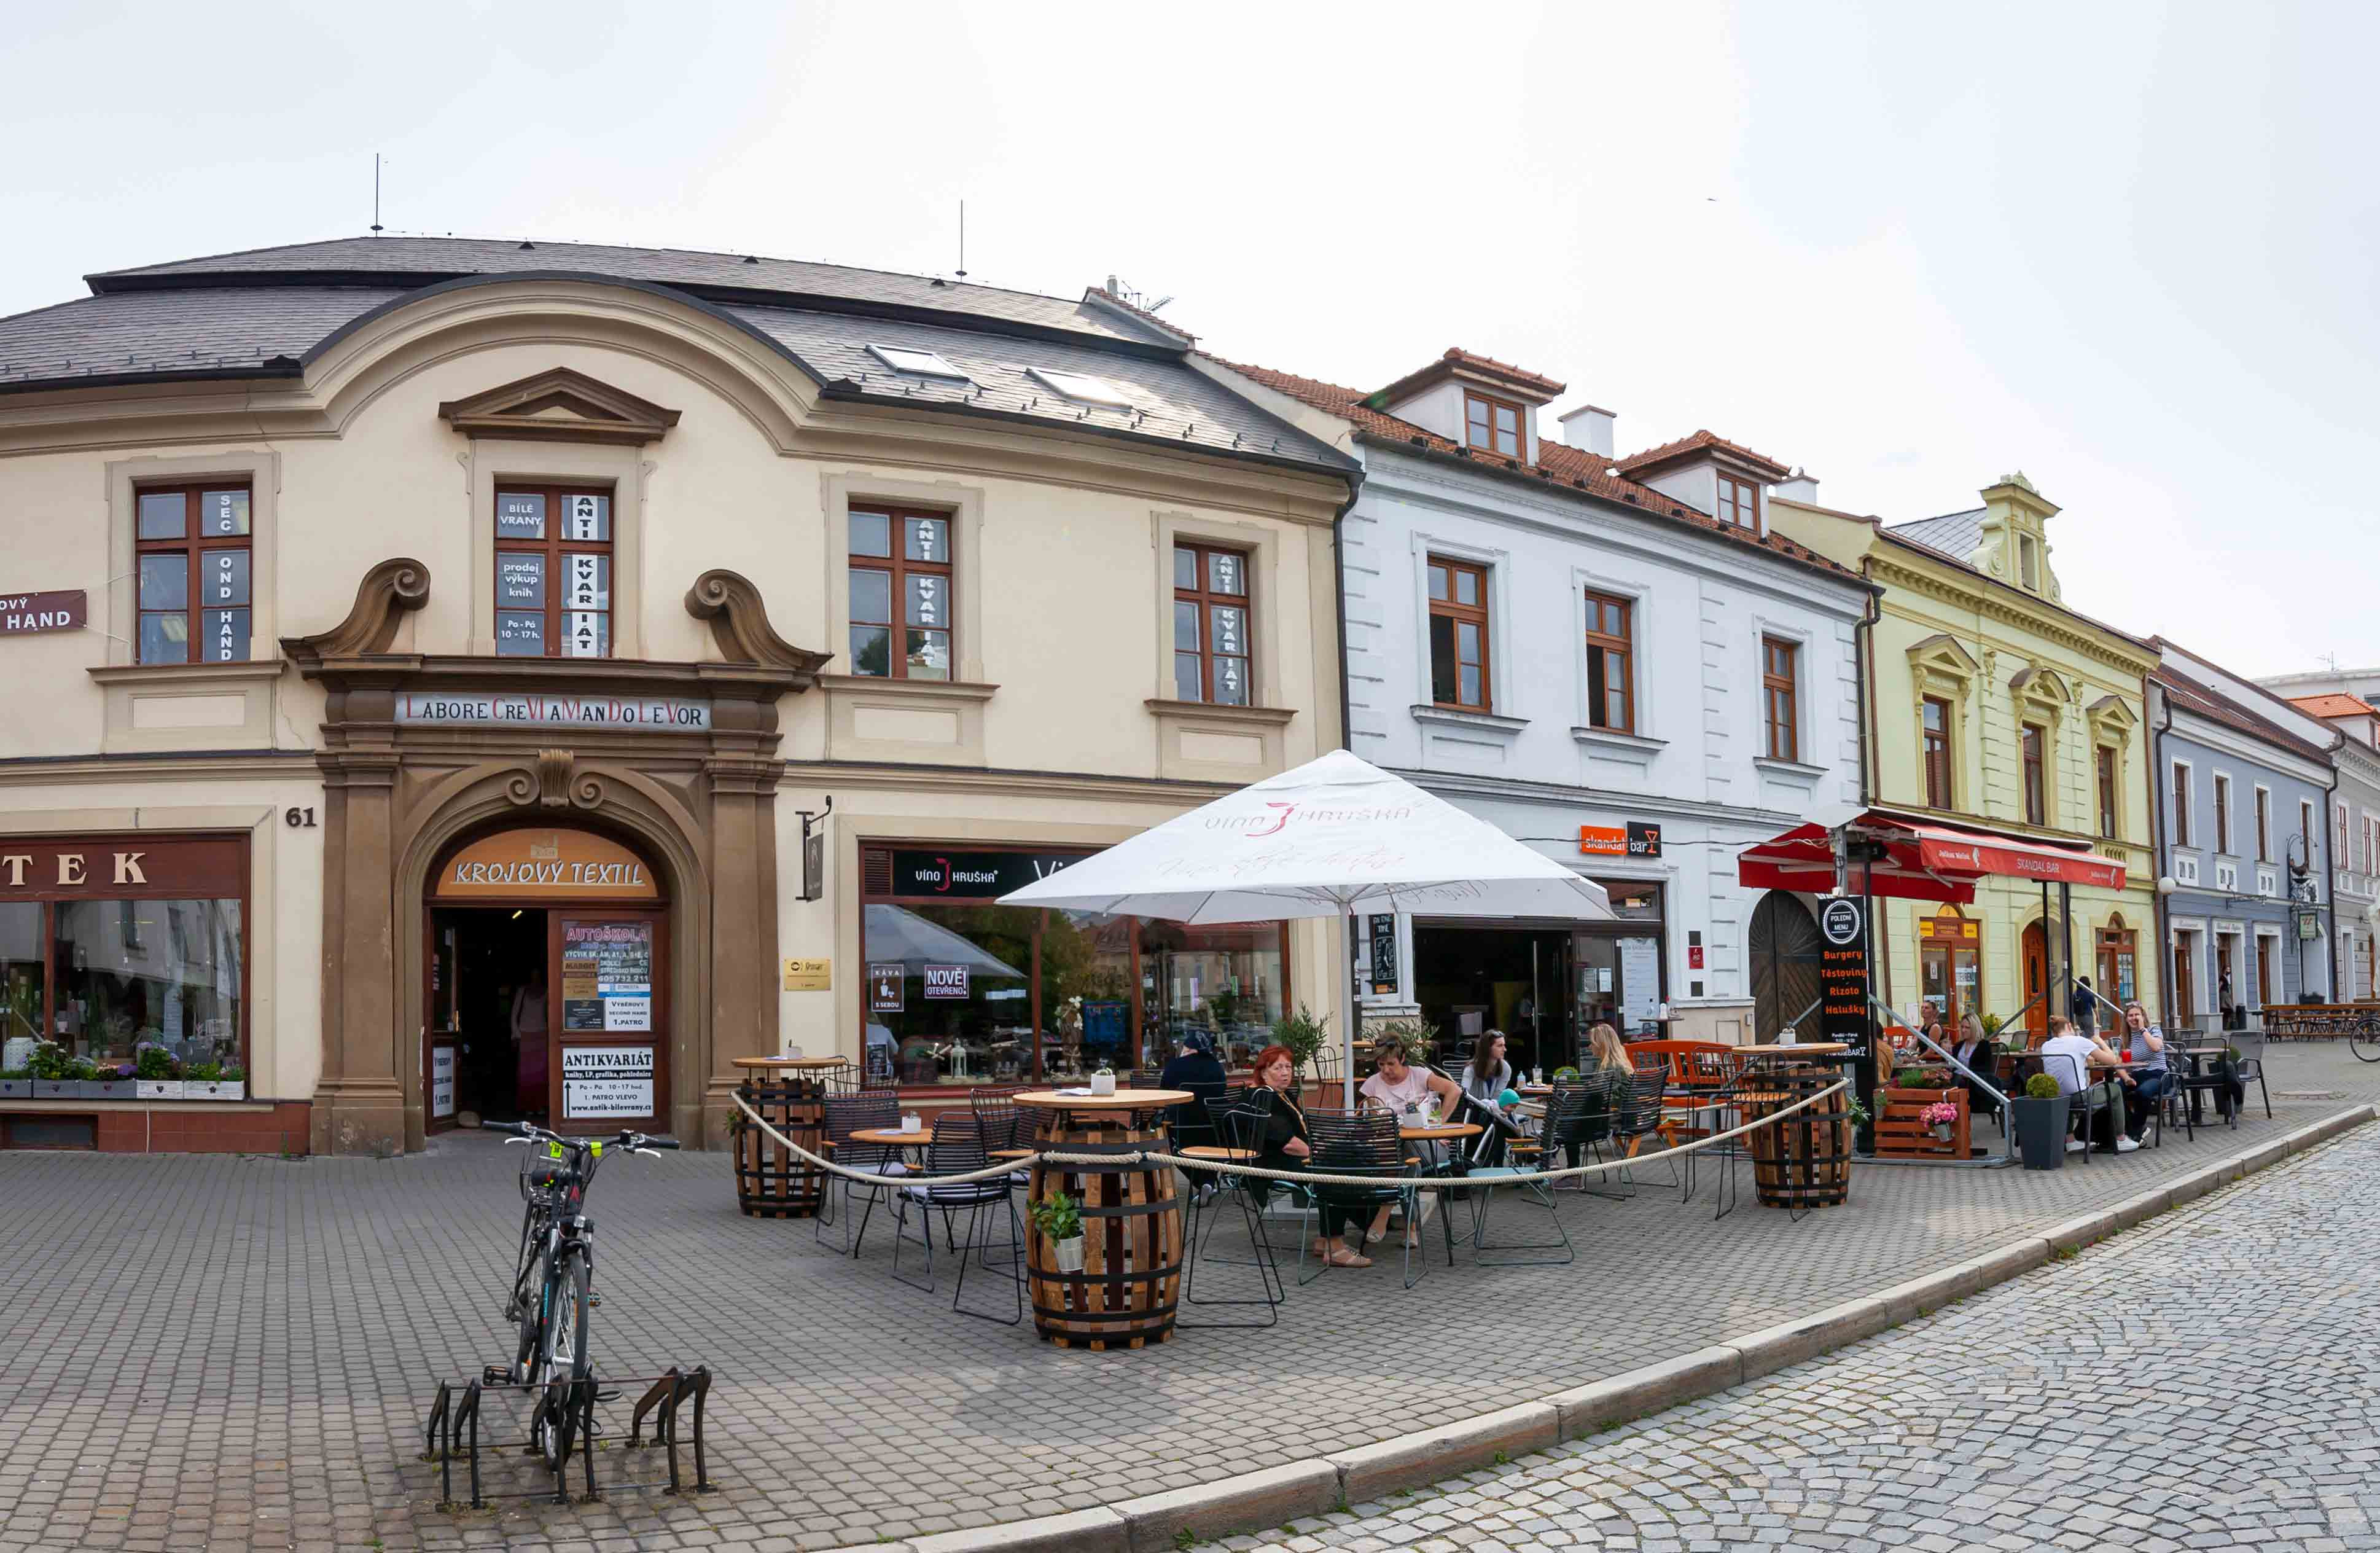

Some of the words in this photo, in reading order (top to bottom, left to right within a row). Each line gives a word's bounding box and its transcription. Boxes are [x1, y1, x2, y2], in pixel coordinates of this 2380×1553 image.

[509, 503, 534, 514] BÍLÉ
[500, 515, 541, 526] VRANY
[504, 563, 539, 573] prodej
[505, 574, 537, 585] výkup
[509, 588, 533, 598] knih
[7, 611, 71, 629] HAND
[285, 807, 318, 827] 61
[1585, 835, 1626, 851] skandal
[1629, 837, 1648, 853] bar
[2017, 858, 2045, 872] SKANDAL
[2046, 863, 2059, 873] BAR
[456, 859, 564, 884] KROJOVÝ
[571, 863, 644, 885] TEXTIL
[566, 925, 649, 942] AUTOŠKOLA
[1824, 950, 1863, 961] Burgery
[1830, 987, 1859, 996] Rizoto
[1825, 1003, 1865, 1015] Halušky
[565, 1051, 652, 1066] ANTIKVARIÁT
